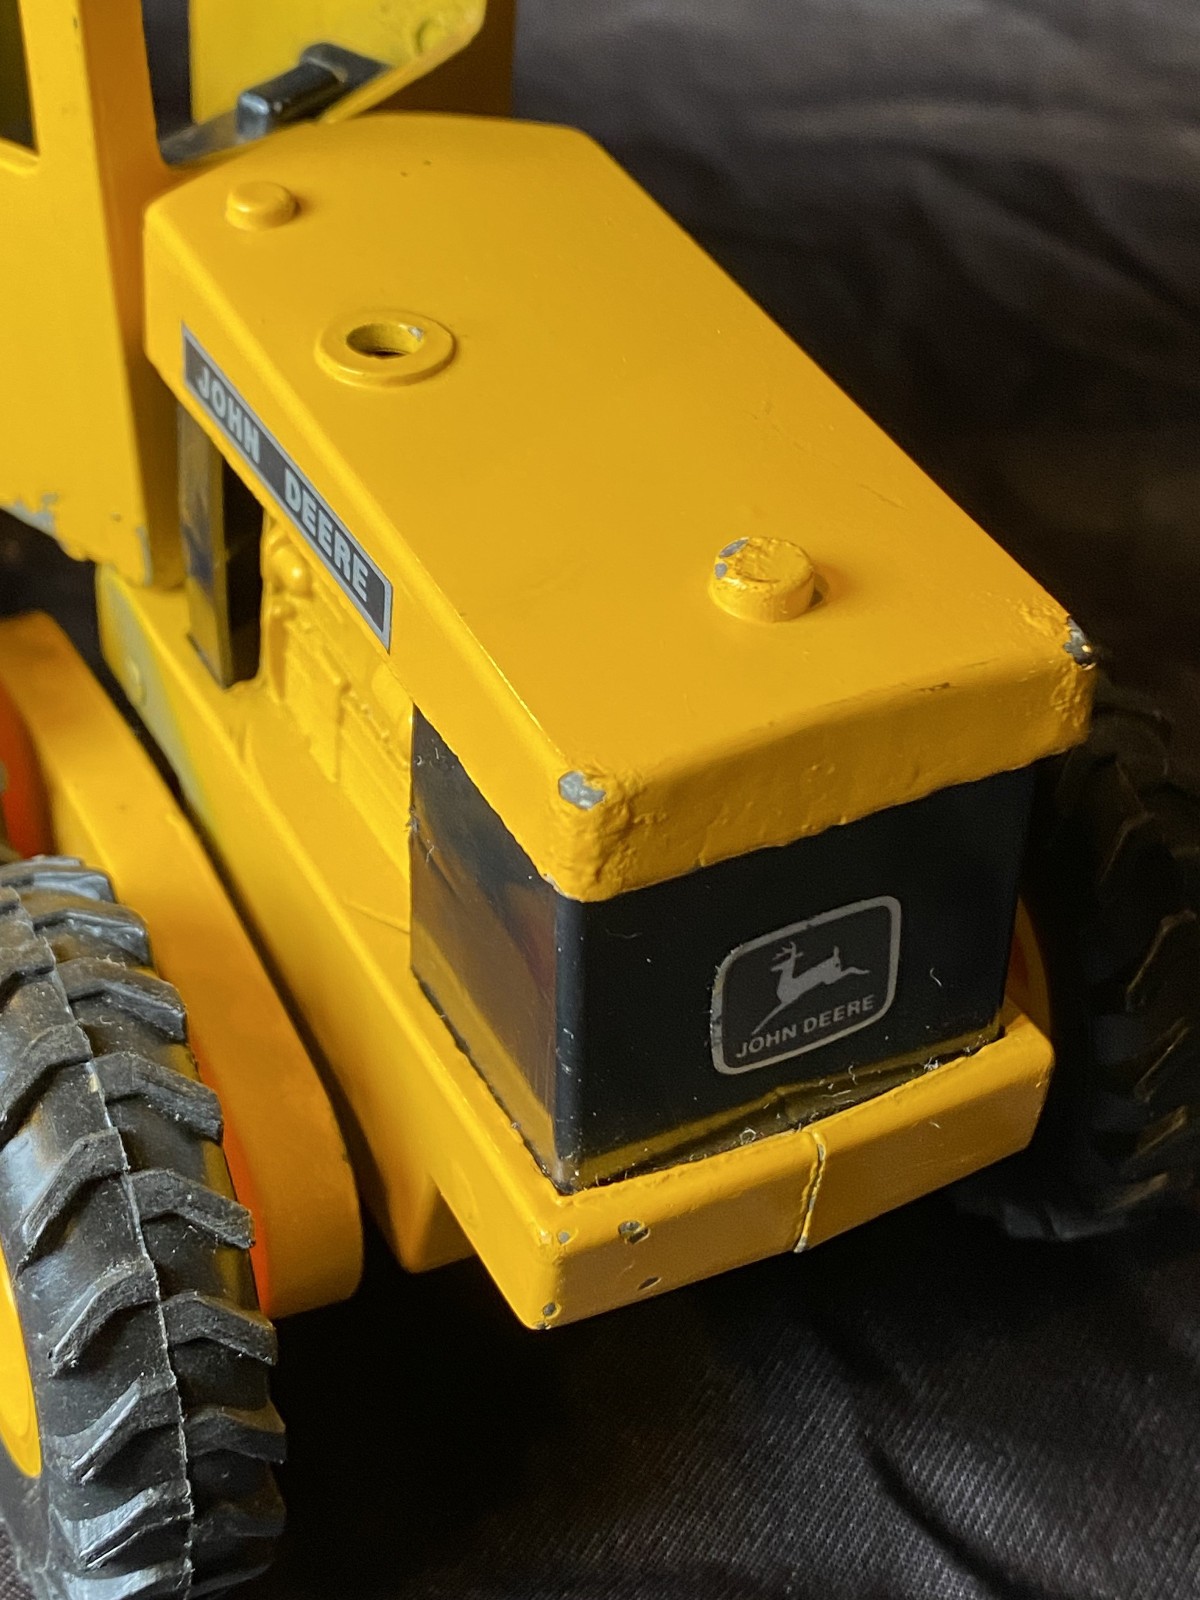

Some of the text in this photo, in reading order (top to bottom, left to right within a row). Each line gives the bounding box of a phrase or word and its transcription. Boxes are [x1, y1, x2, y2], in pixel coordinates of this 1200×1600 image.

[195, 366, 369, 603] JOHN DEERE
[736, 994, 876, 1058] JOHN DEERE
